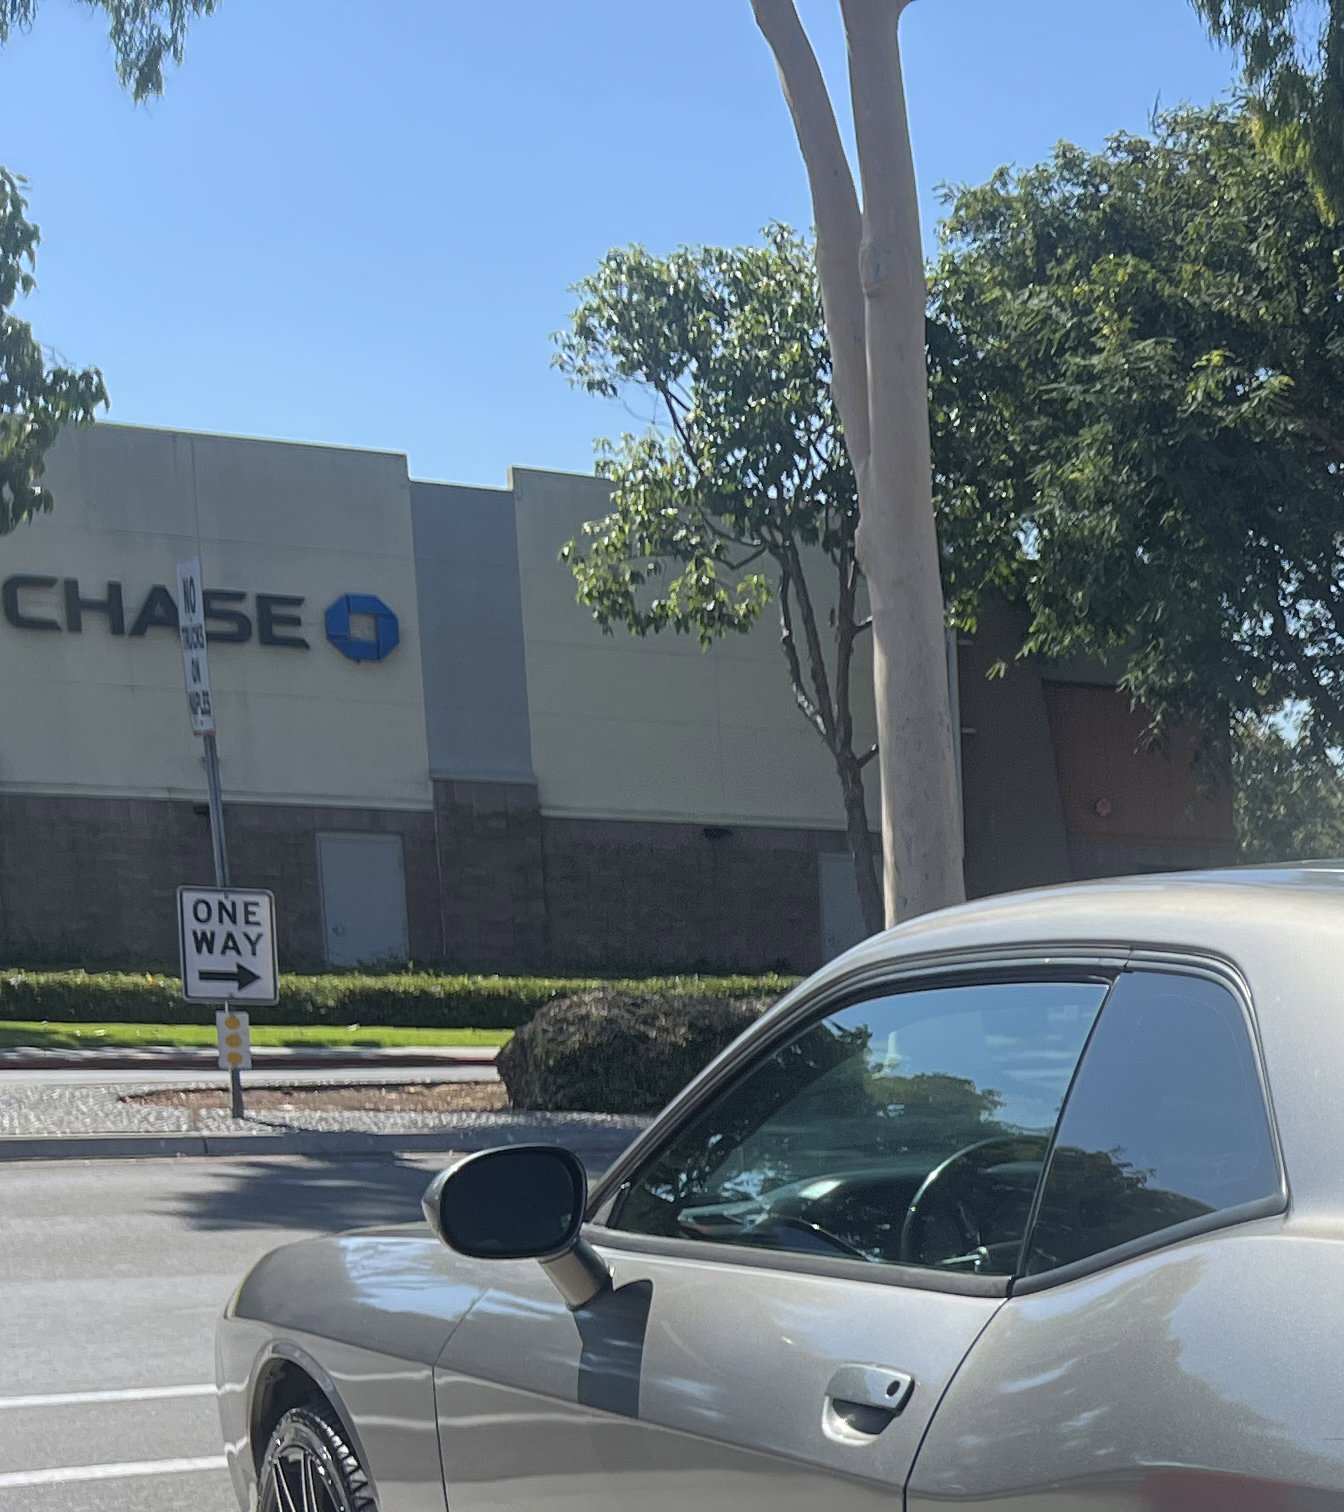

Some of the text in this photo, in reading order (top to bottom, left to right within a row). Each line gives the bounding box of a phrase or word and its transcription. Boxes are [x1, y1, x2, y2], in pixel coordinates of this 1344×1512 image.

[3, 573, 310, 650] CHASE
[193, 899, 262, 926] ONE
[192, 929, 263, 957] WAY
